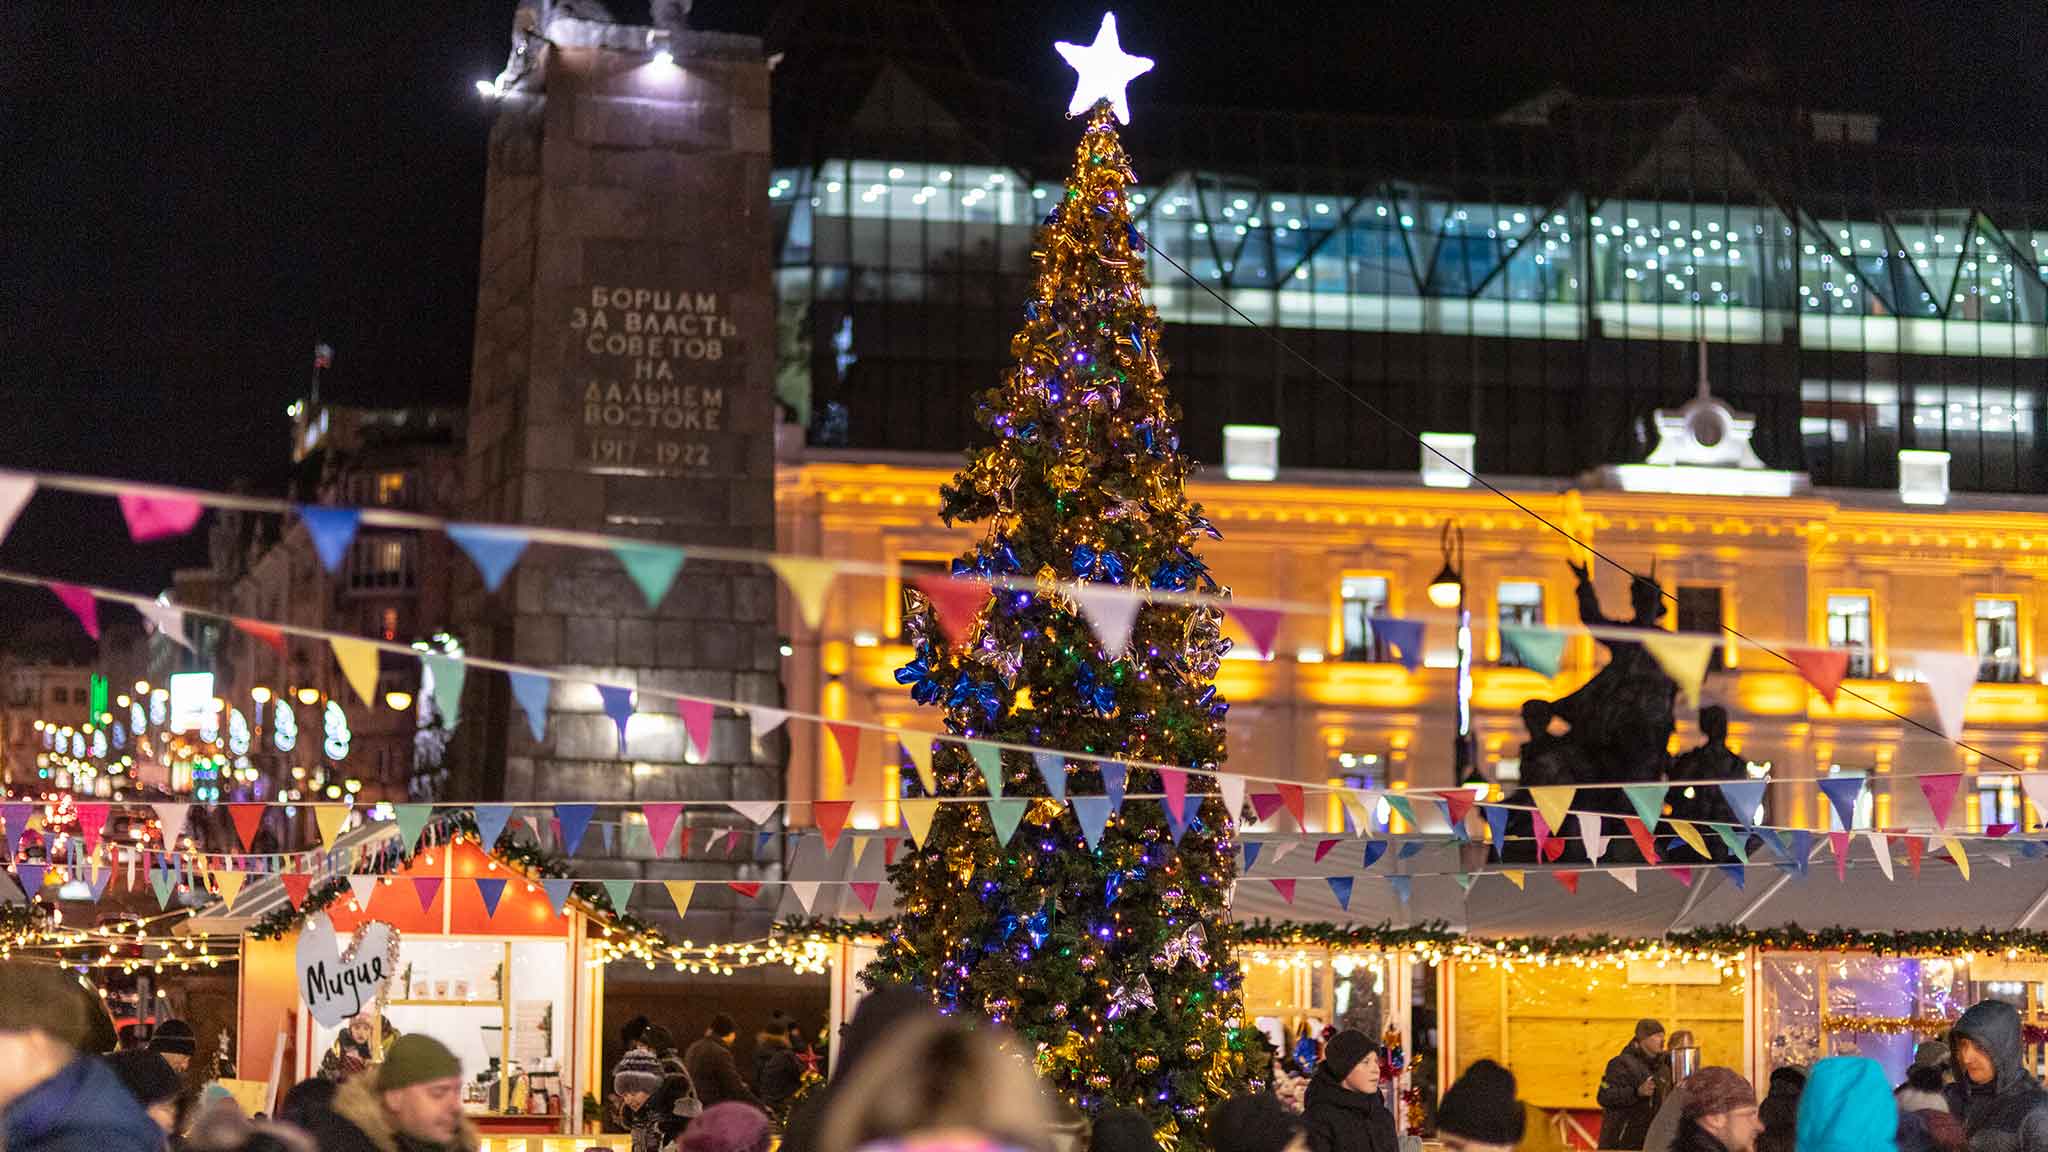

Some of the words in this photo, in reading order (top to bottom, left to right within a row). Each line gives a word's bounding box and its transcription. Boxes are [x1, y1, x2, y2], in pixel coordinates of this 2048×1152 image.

[591, 286, 717, 313] БОРЦАМ
[569, 307, 609, 331] ЗА
[624, 311, 737, 337] ВЛАСТЬ
[586, 333, 723, 360] СОВЕТОВ
[635, 359, 674, 380] НА
[584, 381, 723, 408] ДАЛЬНЕМ
